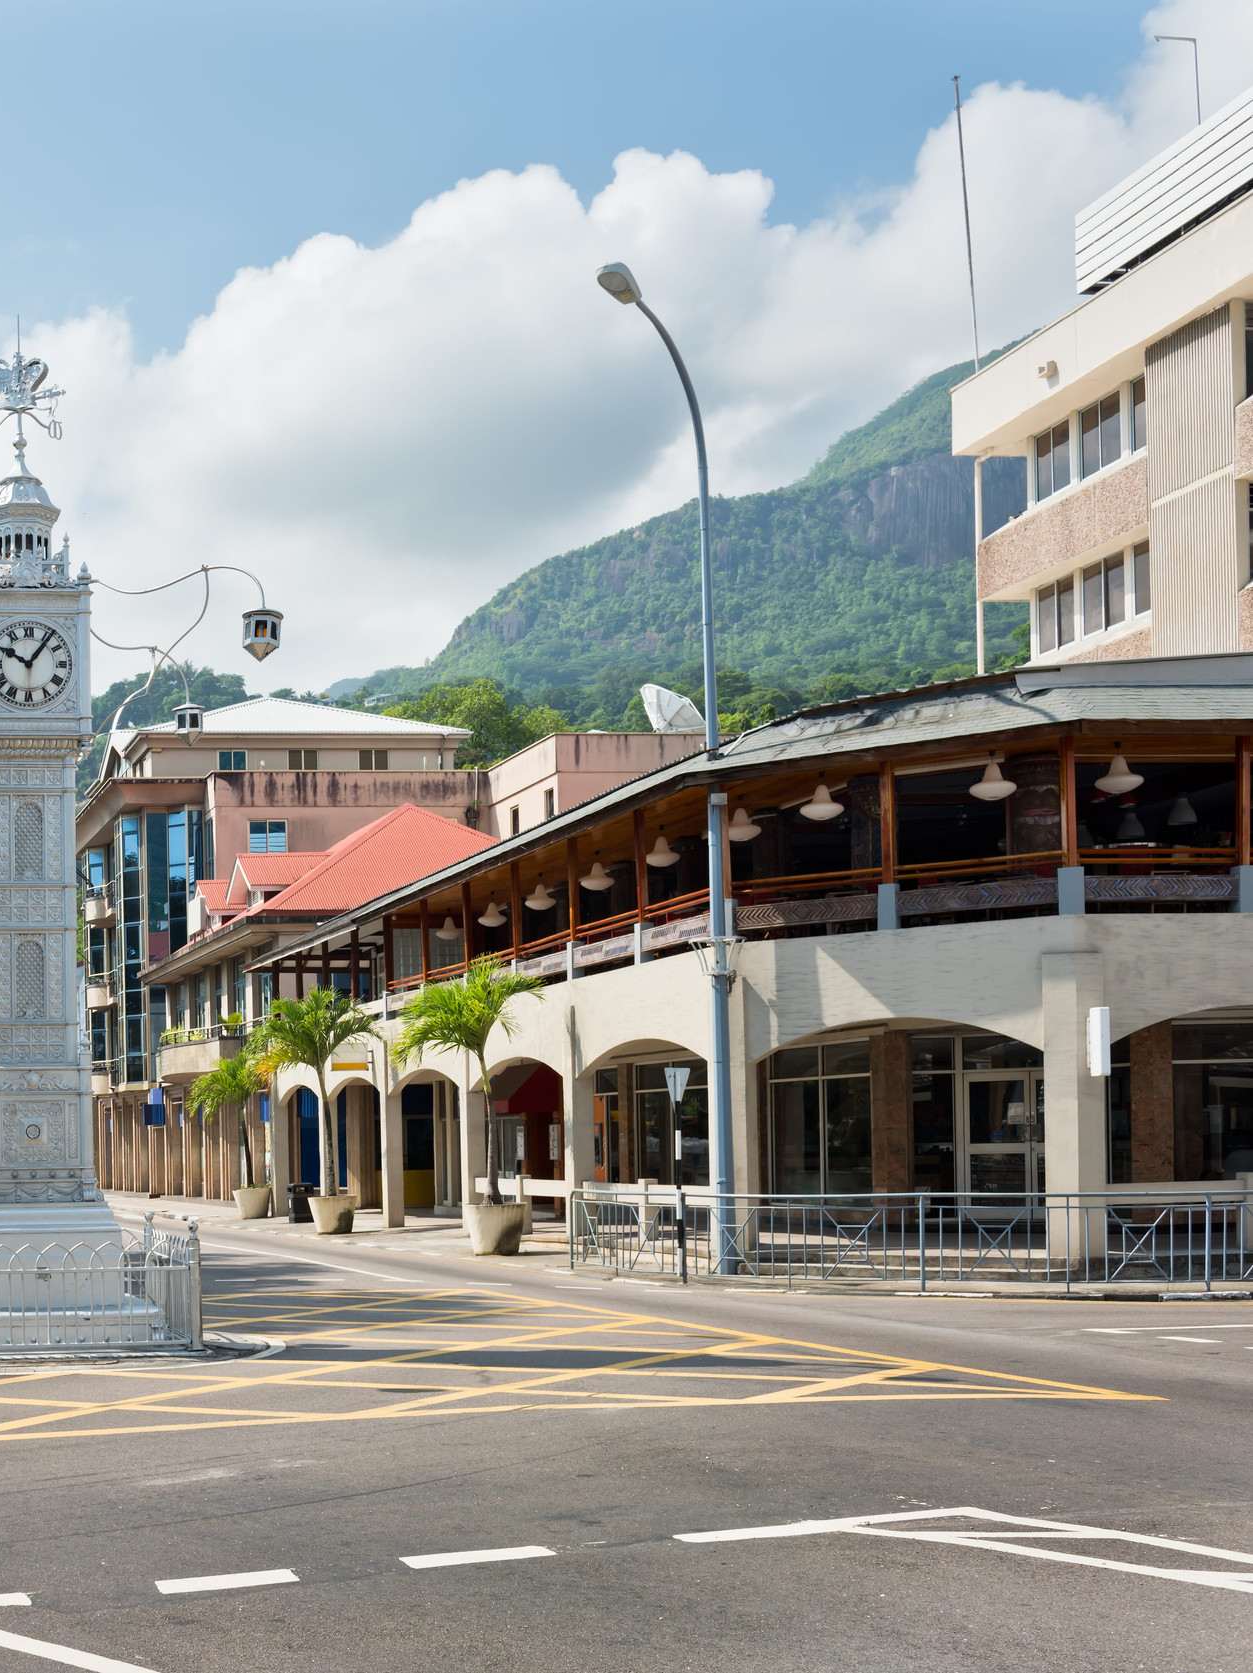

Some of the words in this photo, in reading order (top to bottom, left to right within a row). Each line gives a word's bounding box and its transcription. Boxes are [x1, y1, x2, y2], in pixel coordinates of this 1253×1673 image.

[6, 631, 19, 643] XI
[23, 627, 34, 638] XII
[51, 644, 62, 652] II
[24, 690, 33, 702] VI
[42, 687, 51, 698] V
